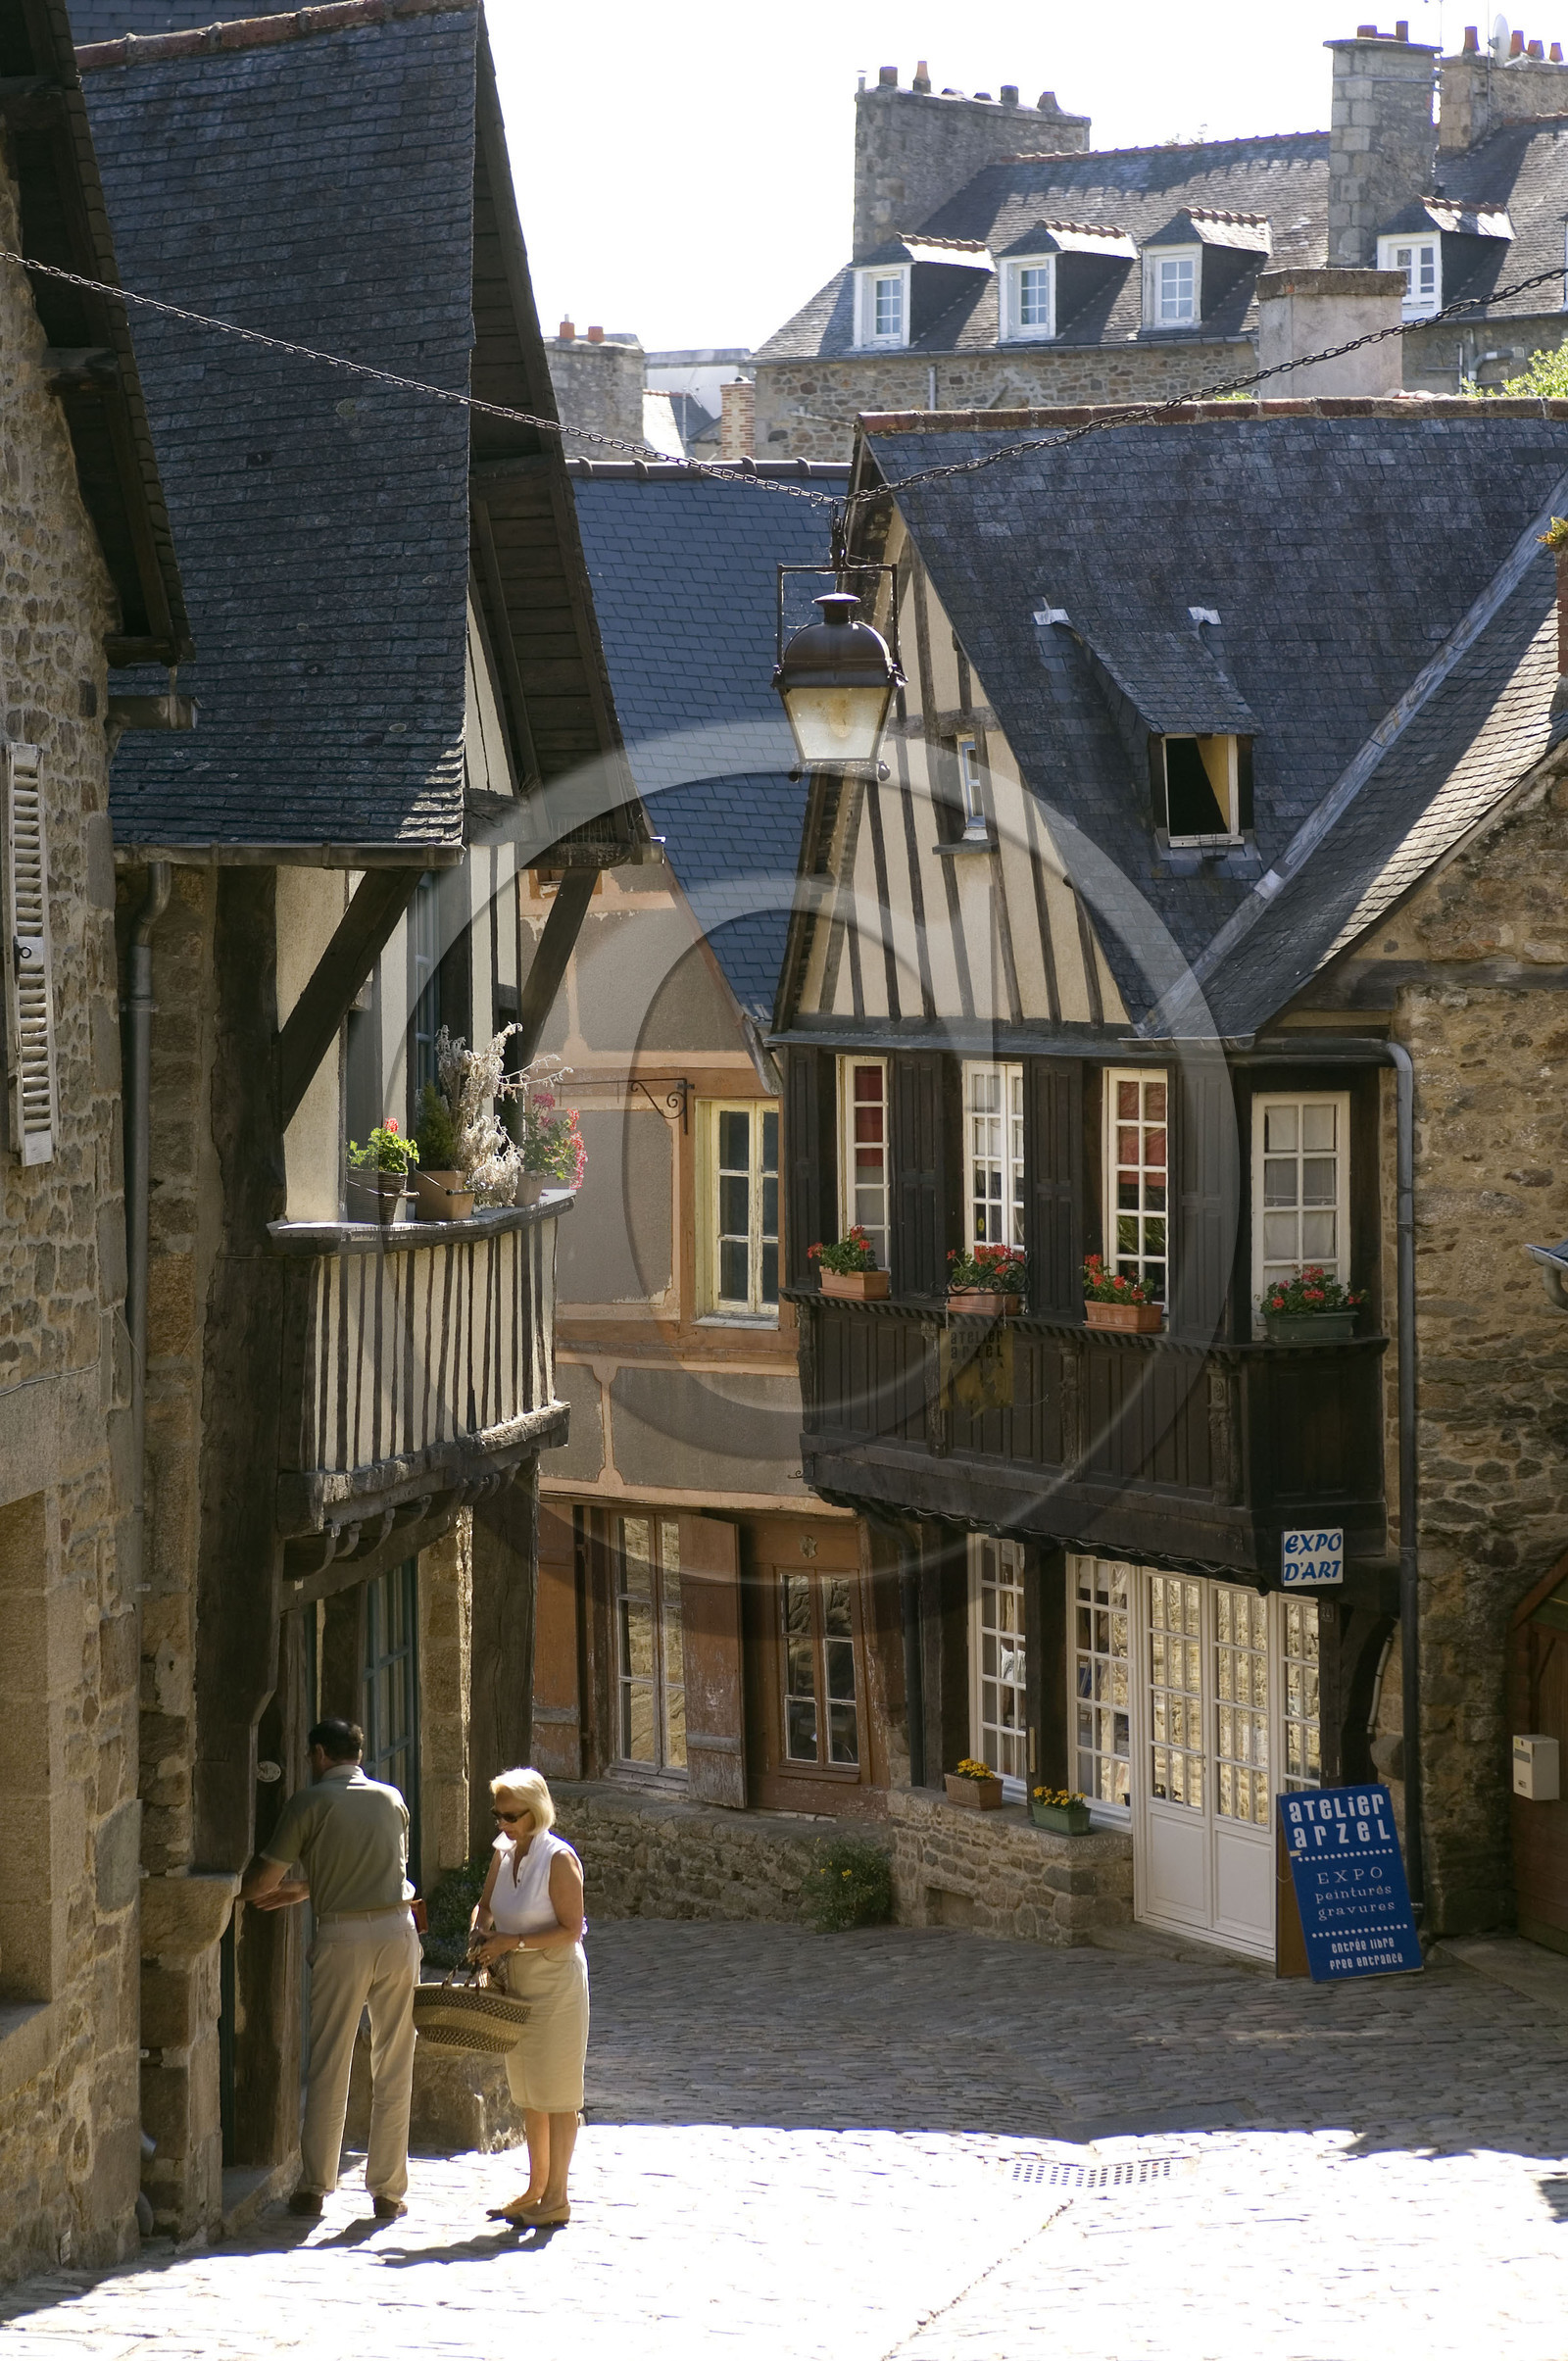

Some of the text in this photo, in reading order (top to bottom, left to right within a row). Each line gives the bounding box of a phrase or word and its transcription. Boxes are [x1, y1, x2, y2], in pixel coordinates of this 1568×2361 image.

[1285, 1533, 1342, 1555] EXPO
[1284, 1560, 1342, 1581] D'ART
[1317, 1866, 1383, 1885] EXPO
[1318, 1901, 1396, 1921] gravures
[1369, 1937, 1395, 1949] libre
[1356, 1952, 1403, 1967] entrance
